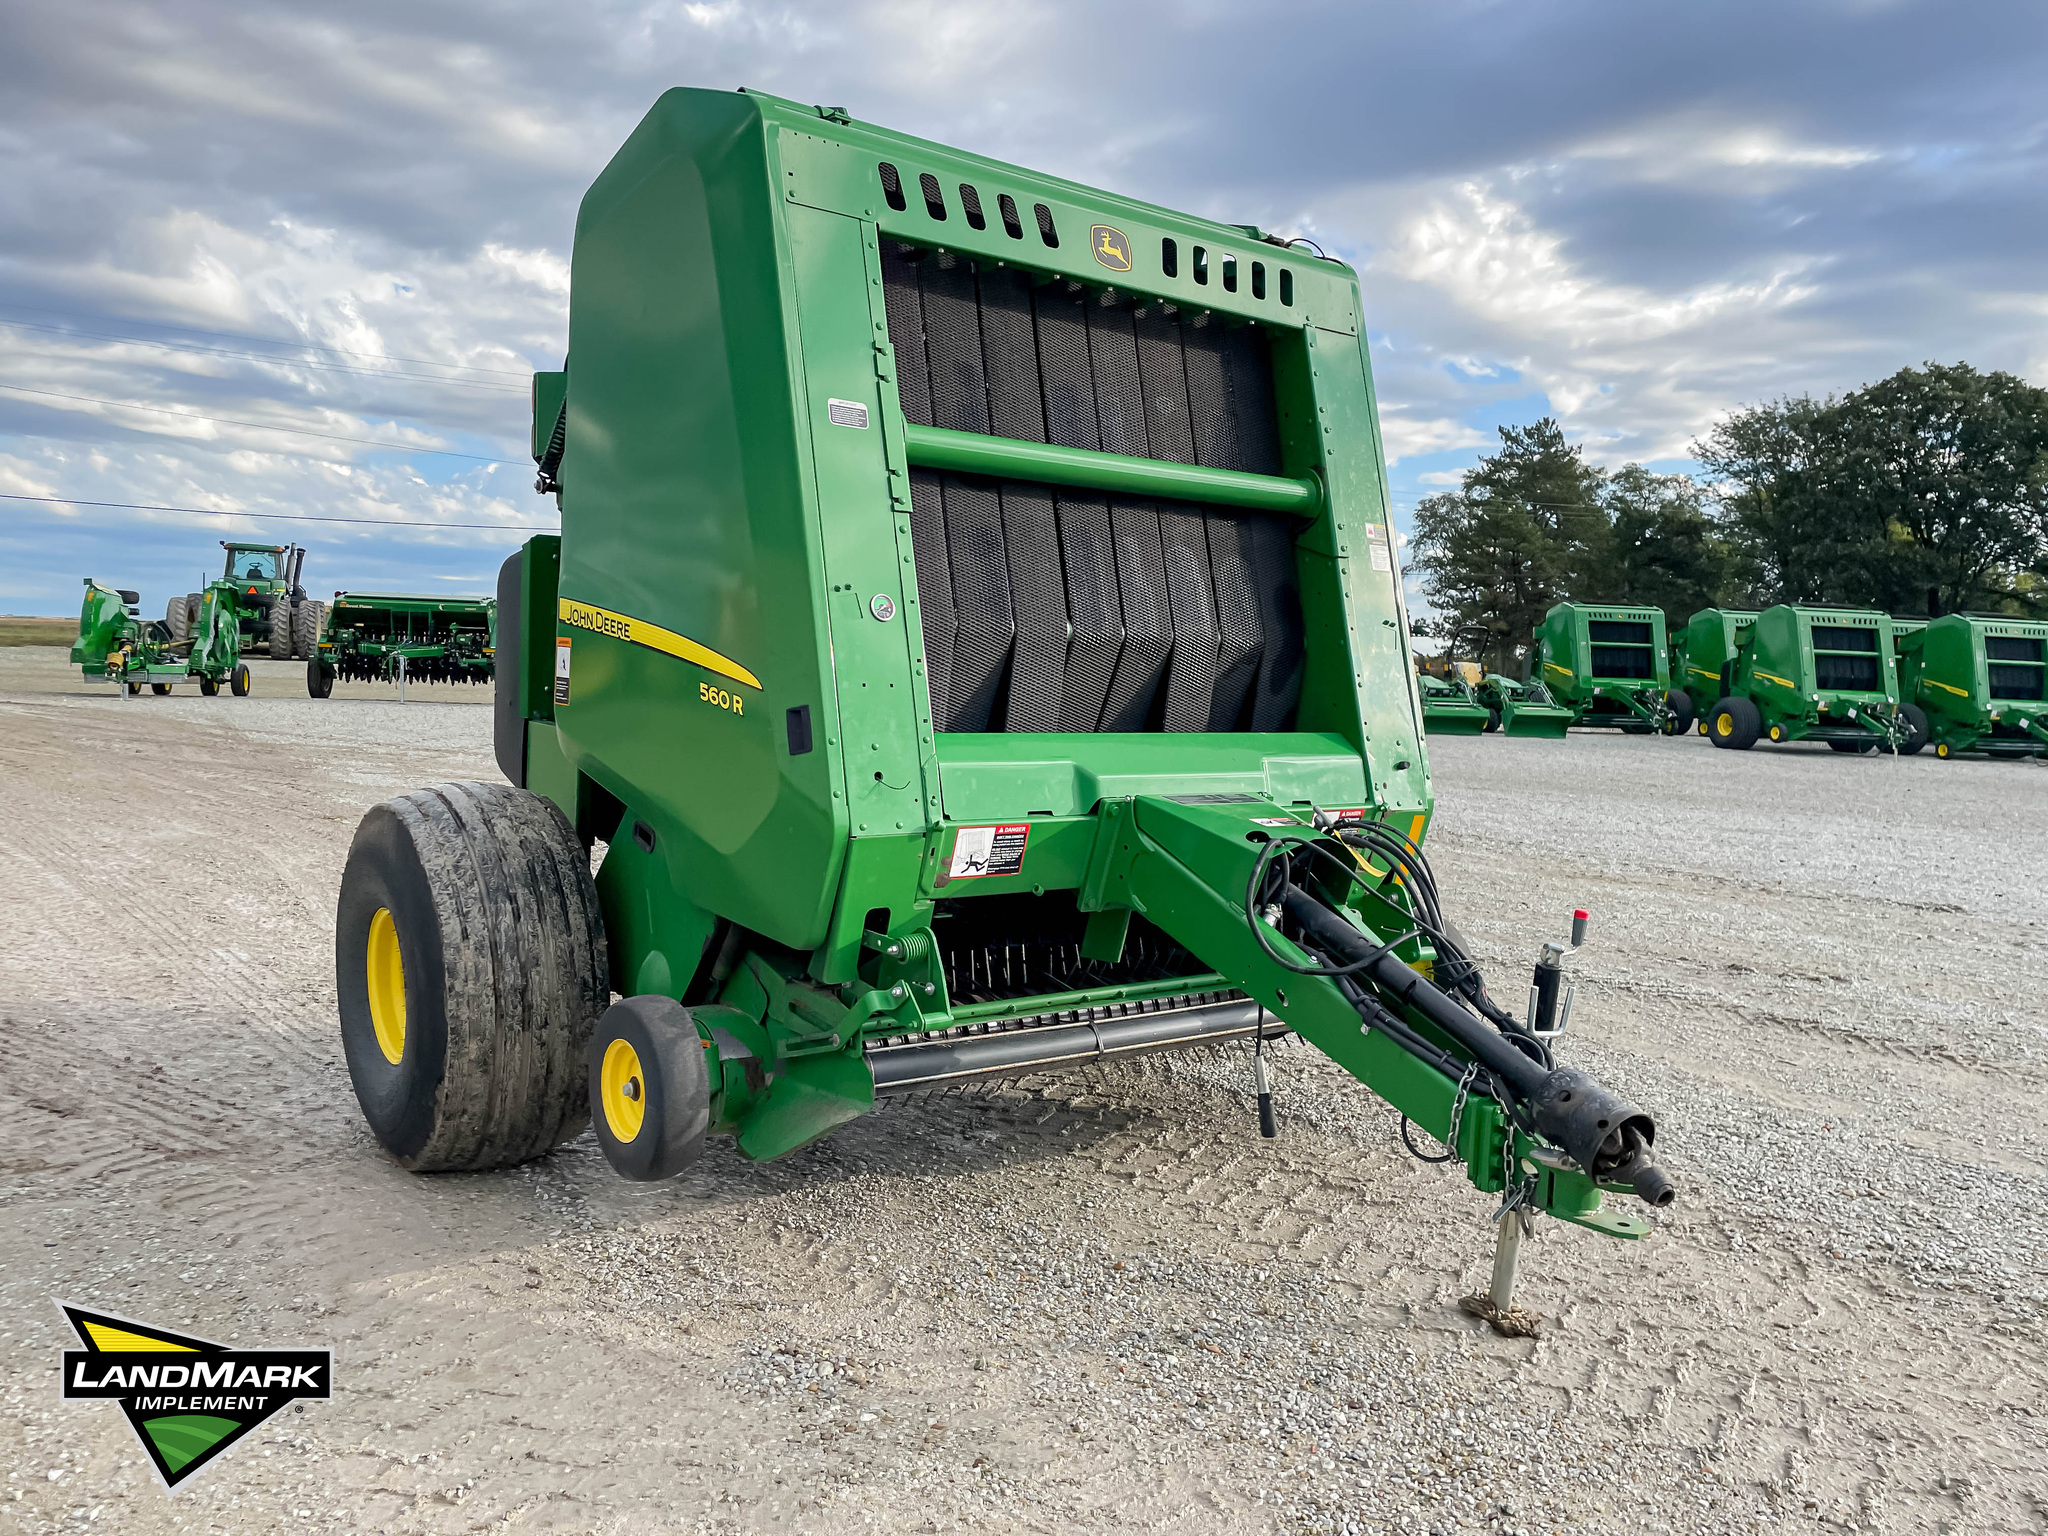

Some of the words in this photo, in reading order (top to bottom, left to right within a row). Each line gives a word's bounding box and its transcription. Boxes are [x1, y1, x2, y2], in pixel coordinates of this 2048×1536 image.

[567, 604, 594, 627] JOHN
[595, 611, 631, 639] DEERE
[699, 681, 731, 710] 560
[732, 693, 744, 716] R
